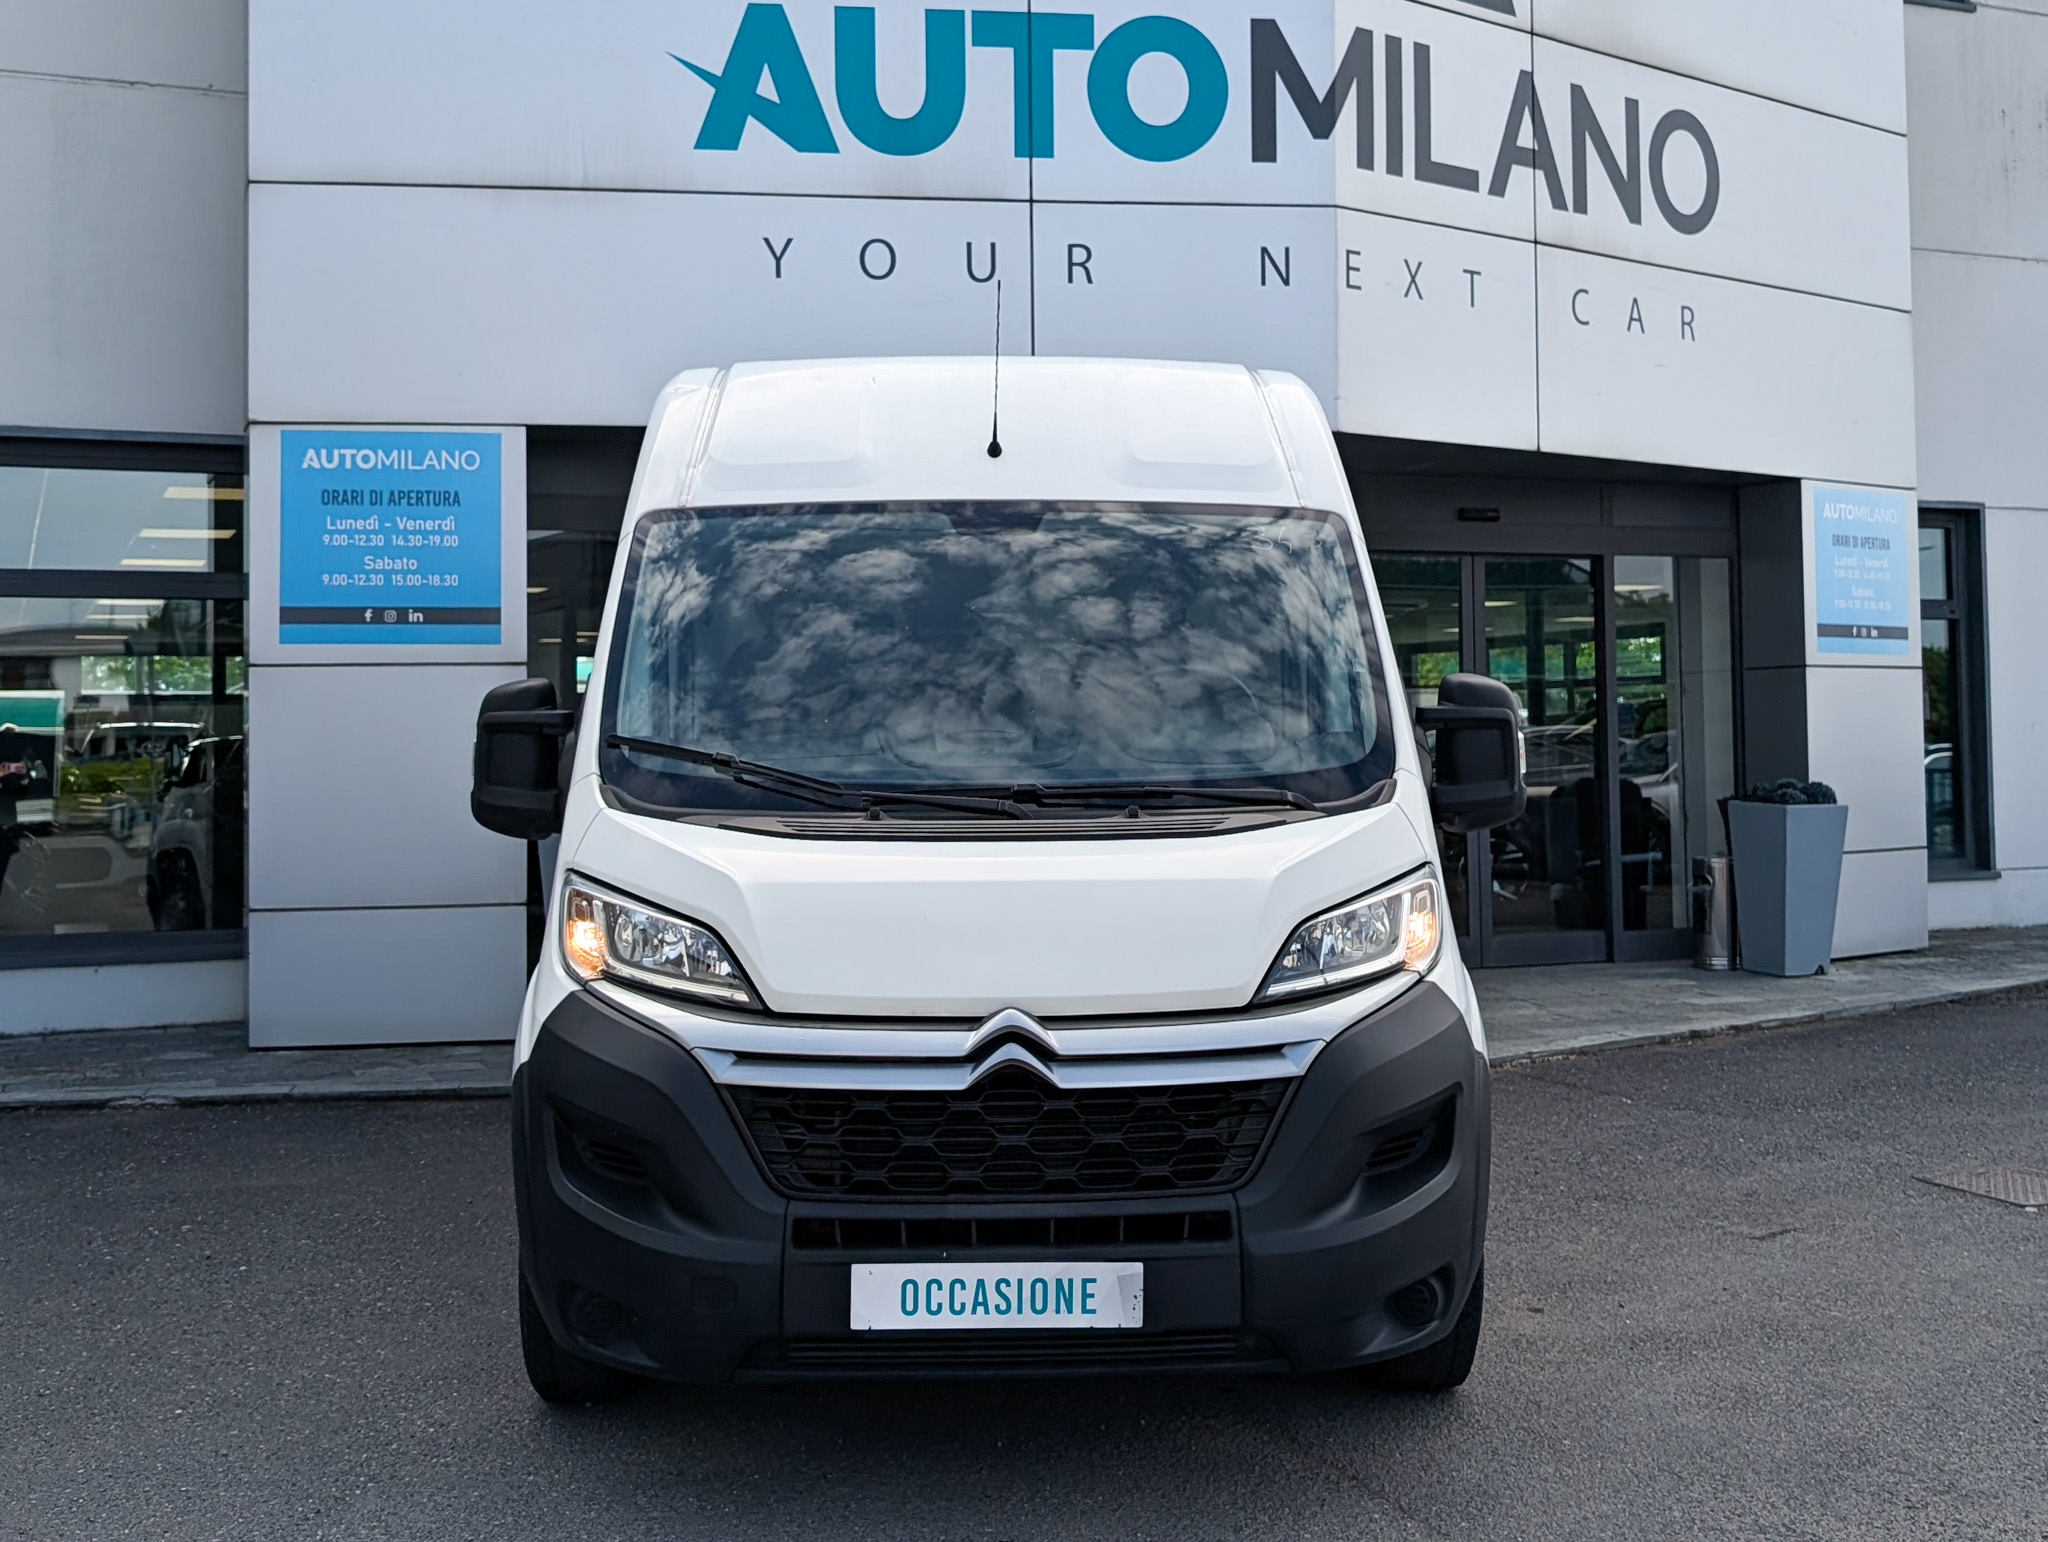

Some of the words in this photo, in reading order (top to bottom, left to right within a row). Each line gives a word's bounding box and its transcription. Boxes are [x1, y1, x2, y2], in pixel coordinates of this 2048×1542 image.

[665, 3, 1720, 235] AUTOMILANO
[762, 236, 1095, 284] YOUR
[1259, 246, 1482, 308] NEXT
[1571, 288, 1696, 342] CAR
[302, 448, 481, 470] AUTOMILANO
[321, 489, 364, 506] ORARI
[369, 489, 383, 506] DI
[388, 490, 461, 507] APERTURA
[326, 514, 379, 530] Lunedì
[396, 515, 455, 531] Venerdì
[1823, 502, 1897, 524] AUTOMILANO
[322, 534, 385, 546] 9.00-12.30
[391, 534, 459, 547] 14.30-19.00
[364, 555, 418, 571] Sabato
[322, 573, 384, 586] 9.00-12.30
[391, 574, 459, 587] 15.00-18.30
[900, 1278, 1098, 1316] OCCASIONE
